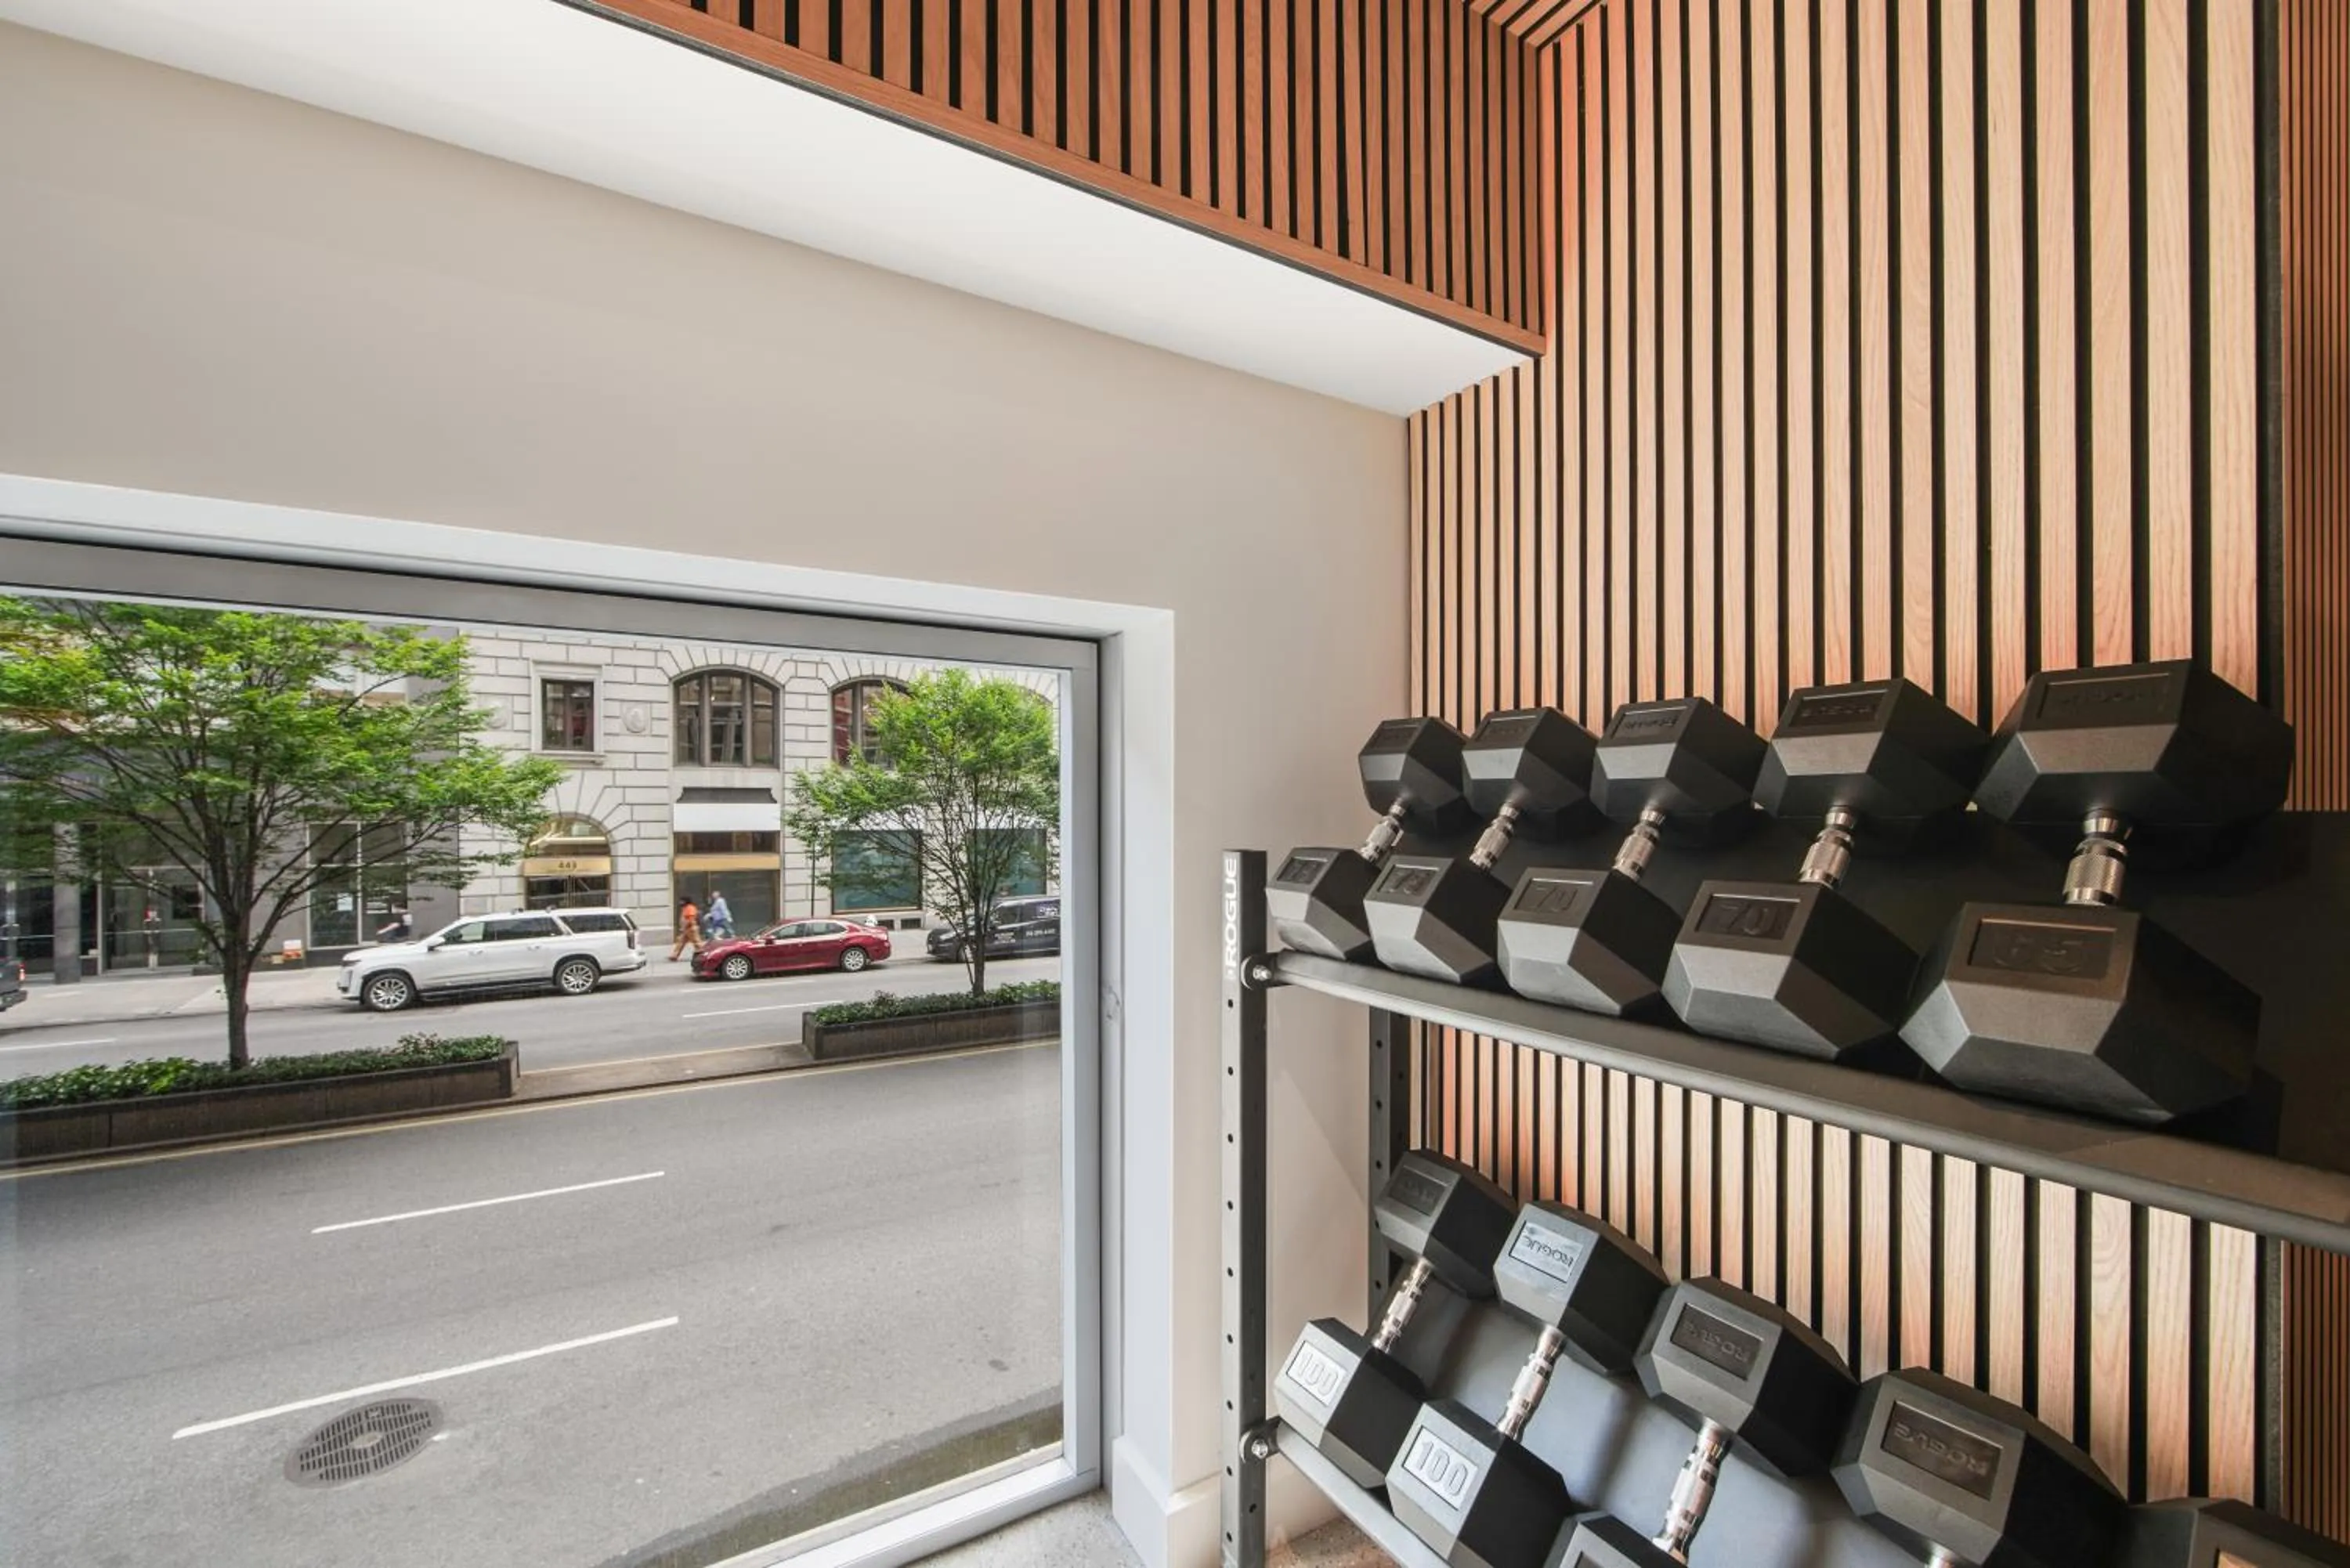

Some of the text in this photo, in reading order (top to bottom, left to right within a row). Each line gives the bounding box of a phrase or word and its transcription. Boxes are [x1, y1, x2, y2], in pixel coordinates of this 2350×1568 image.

[1224, 858, 1238, 967] ROGUE
[1528, 885, 1579, 912] 70
[1718, 901, 1780, 937] 70
[1297, 1352, 1340, 1396] 100
[1416, 1440, 1470, 1498] 100
